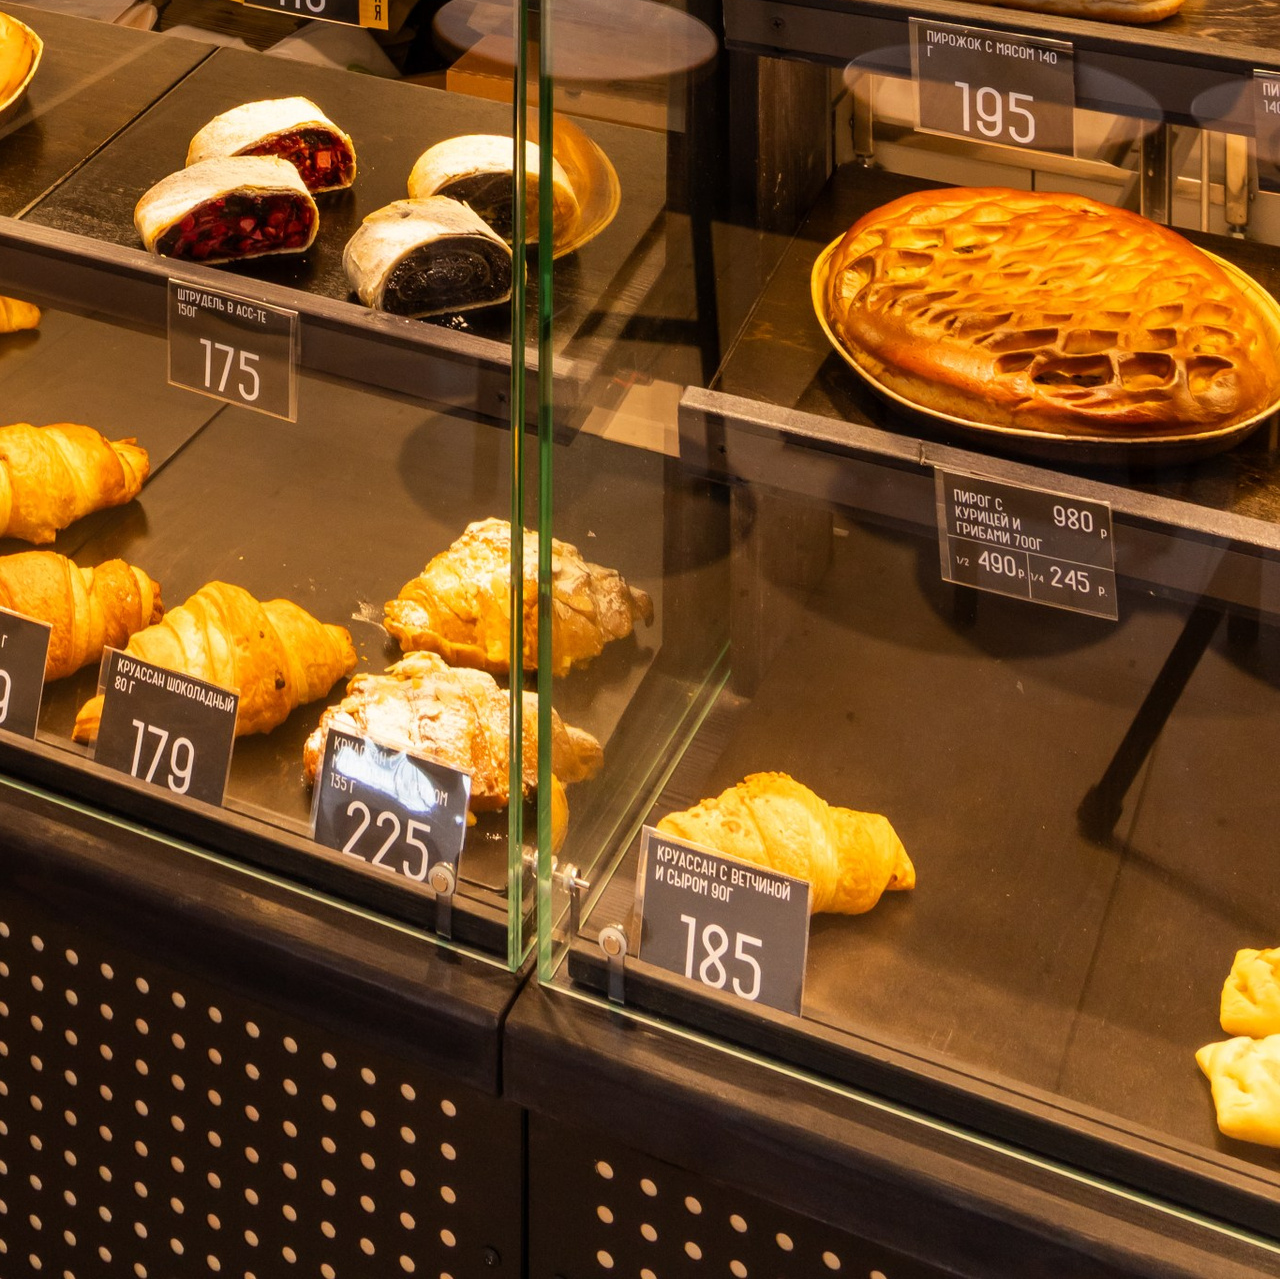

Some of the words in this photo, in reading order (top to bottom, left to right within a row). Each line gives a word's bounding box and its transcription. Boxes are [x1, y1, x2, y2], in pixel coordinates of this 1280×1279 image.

[926, 30, 981, 52] ПИРОЖОК
[985, 40, 992, 53] С
[996, 42, 1035, 61] МЯСОМ
[1039, 50, 1057, 65] 140
[927, 46, 933, 57] Г
[955, 81, 1035, 143] 195
[200, 338, 259, 401] 175
[954, 489, 991, 508] ПИРОГ
[995, 498, 1003, 511] С
[955, 505, 1009, 528] КУРИЦЕЙ
[1013, 516, 1021, 531] И
[1053, 505, 1093, 533] 980
[956, 521, 1011, 544] ГРИБАМИ
[1014, 534, 1042, 551] 700Г
[132, 719, 195, 795] 179
[342, 800, 431, 882] 225
[655, 865, 664, 881] И
[667, 868, 708, 896] СЫРОМ
[712, 883, 733, 903] 90Г
[657, 844, 717, 878] КРУАССАН
[720, 864, 728, 880] С
[731, 868, 791, 901] ВЕТЧИНОЙ
[681, 914, 762, 1001] 185
